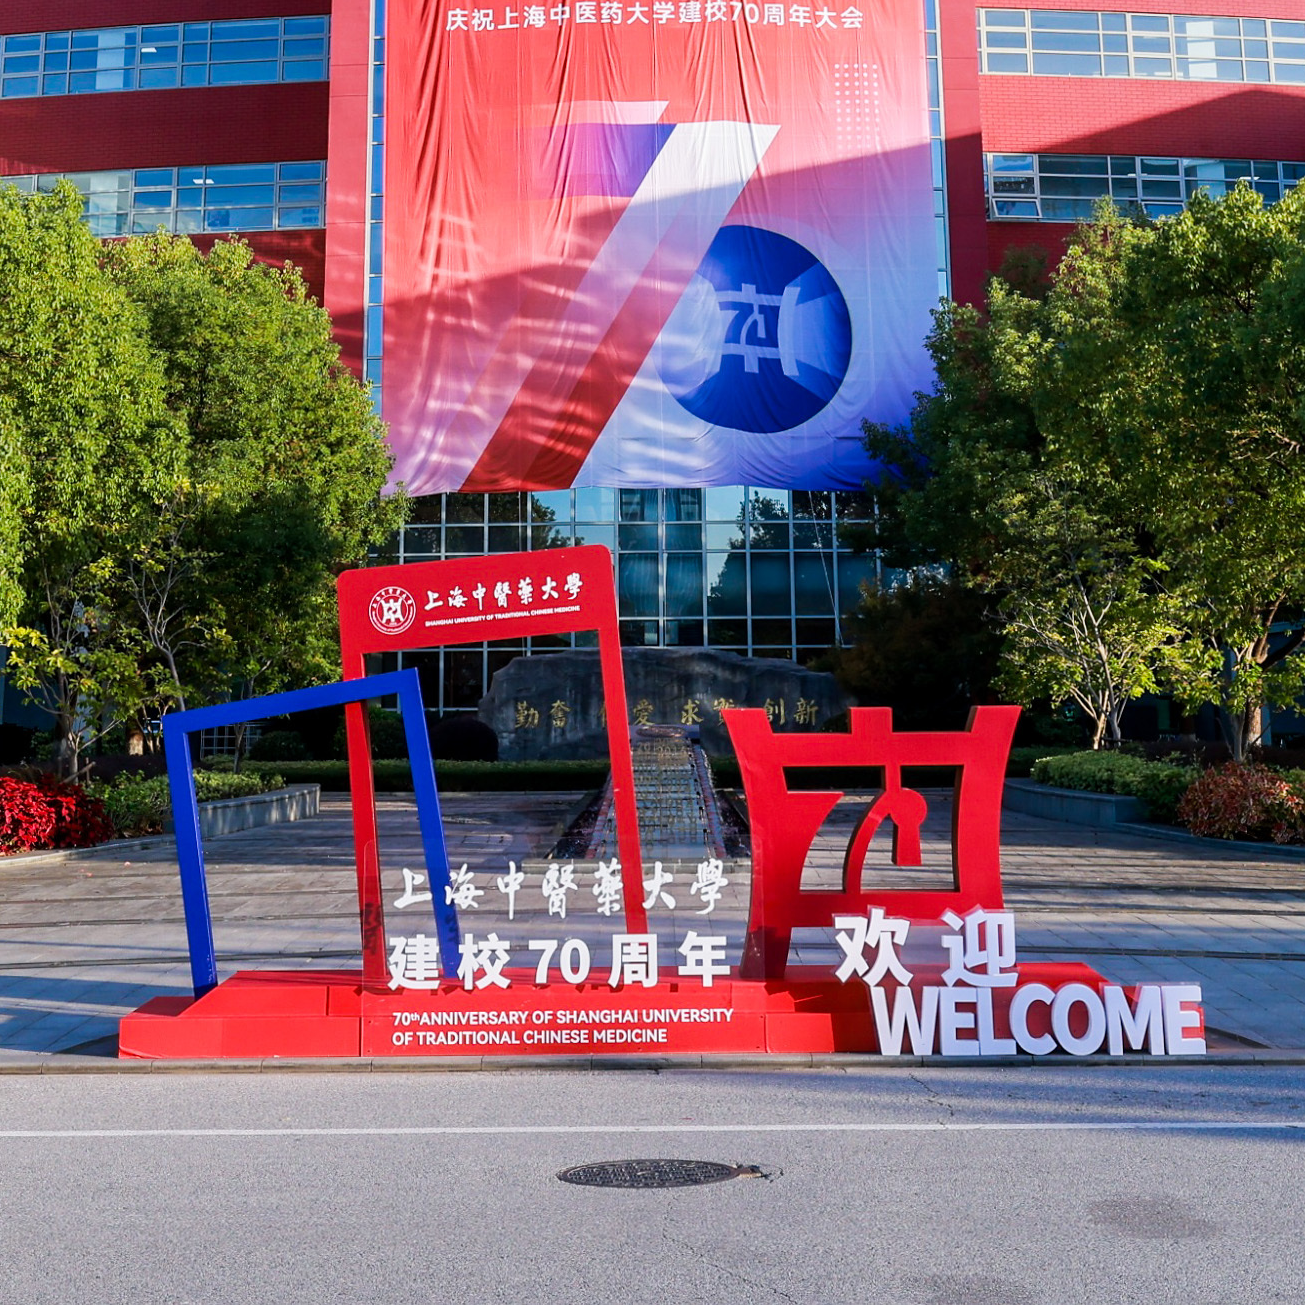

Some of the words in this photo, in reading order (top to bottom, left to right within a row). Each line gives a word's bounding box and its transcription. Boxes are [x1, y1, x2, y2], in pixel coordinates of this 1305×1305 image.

[445, 0, 863, 32] 庆祝上海中医药大学建校70周年大会
[425, 572, 583, 611] 上海中醫藥大學
[425, 619, 454, 627] SHANGHAI
[455, 615, 486, 624] UNIVERSITY
[495, 611, 530, 620] TRADITIONAL
[531, 608, 554, 616] CHINESE
[554, 605, 581, 614] MEDICINE
[600, 699, 655, 726] 愛
[393, 857, 729, 920] 上海中醫藥大學
[387, 931, 731, 991] 建校70周年
[834, 906, 1019, 988] 欢迎
[532, 1011, 553, 1025] OF
[557, 1010, 638, 1024] SHANGHAI
[643, 1009, 734, 1023] UNIVERSITY
[870, 982, 1207, 1056] WELCOME
[393, 1032, 413, 1045] OF
[417, 1031, 520, 1045] TRADITIONAL
[523, 1030, 589, 1044] CHINESE
[593, 1029, 668, 1043] MEDICINE
